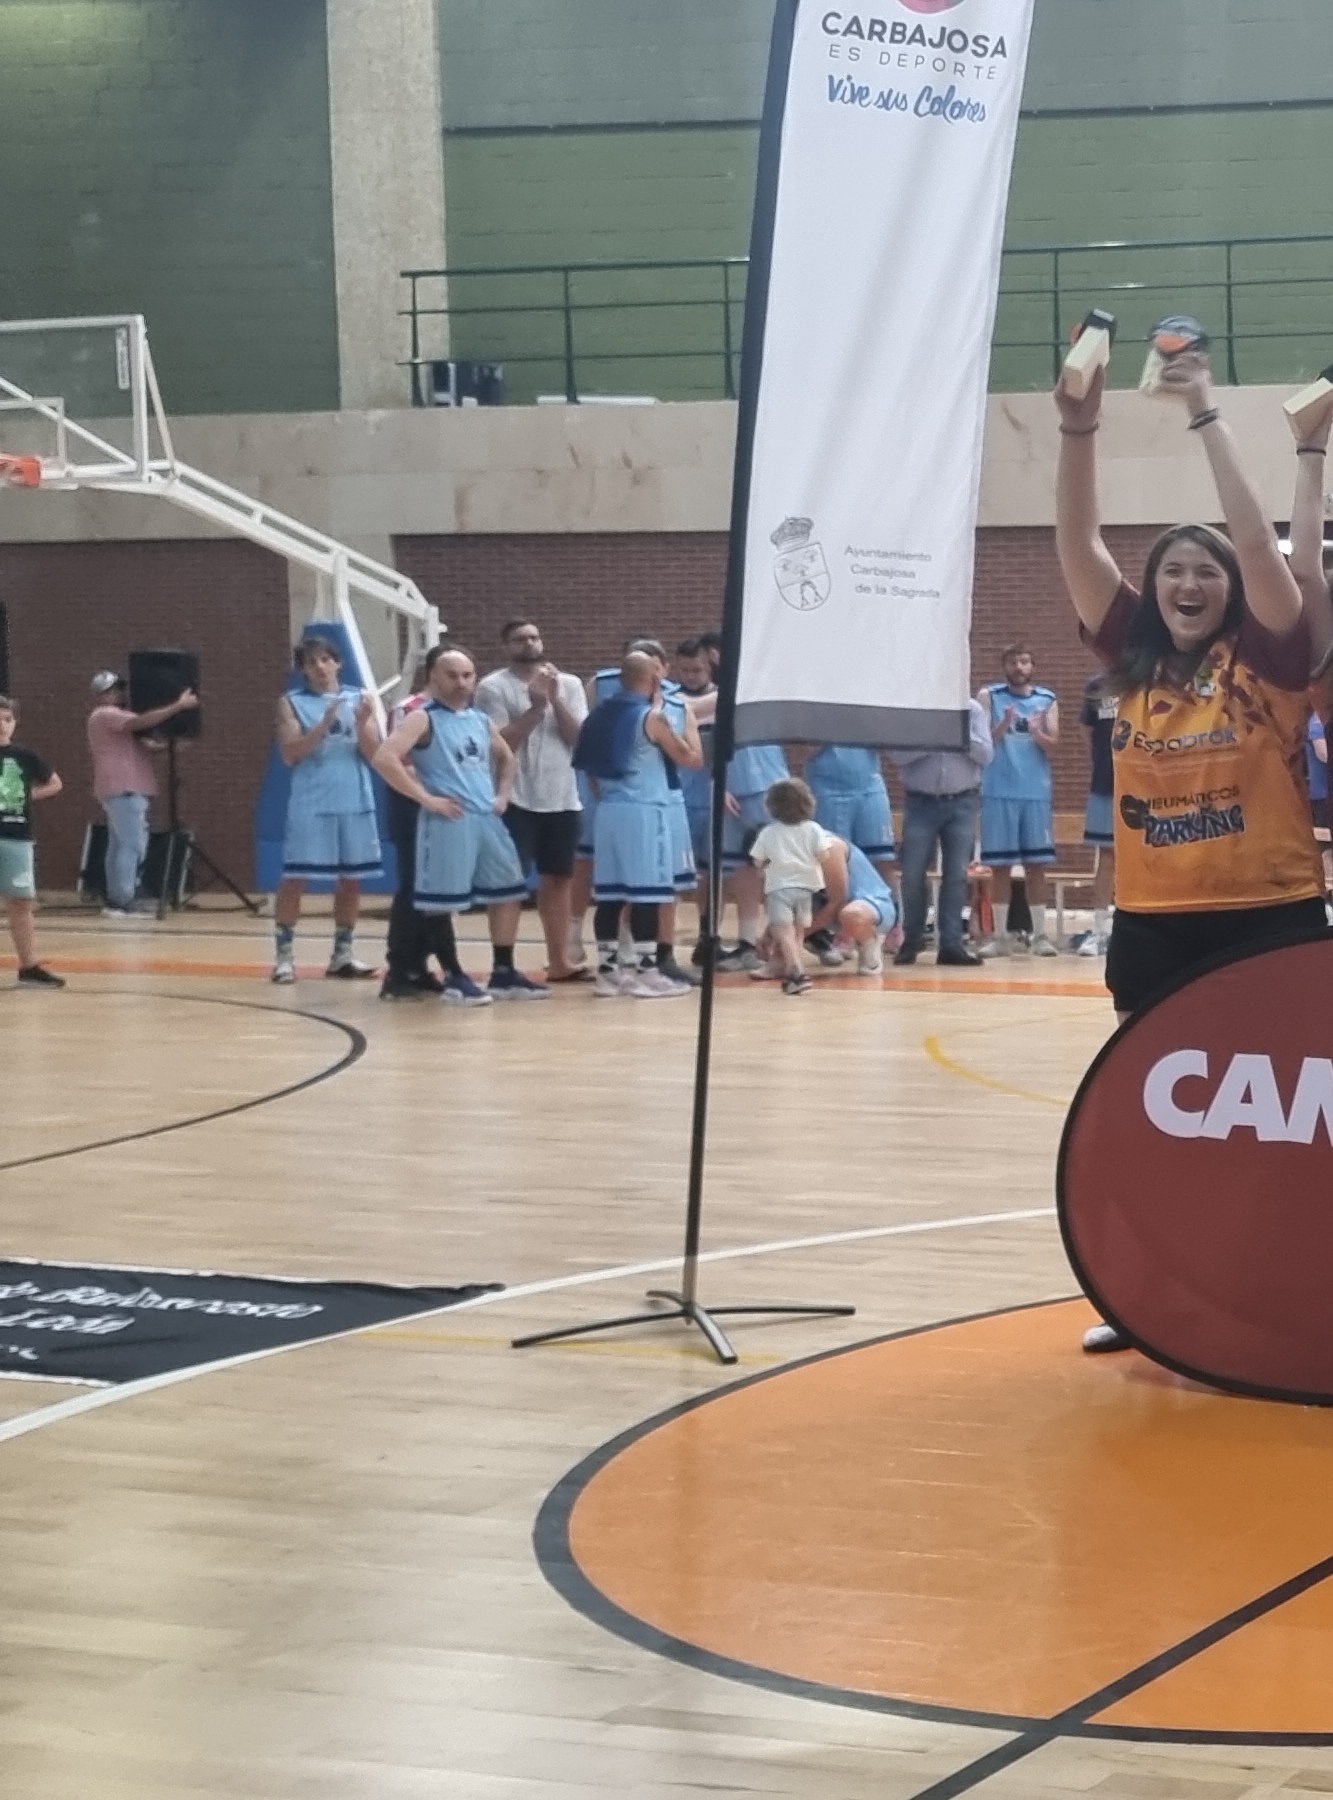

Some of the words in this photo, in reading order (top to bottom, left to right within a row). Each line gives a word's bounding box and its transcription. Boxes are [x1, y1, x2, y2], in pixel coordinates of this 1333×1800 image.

[821, 11, 1008, 59] CARBAJOSA
[828, 44, 861, 62] ES
[879, 51, 997, 80] DEPORTE
[827, 74, 872, 108] Vive
[913, 85, 986, 125] Colores
[1143, 803, 1246, 848] PARKING
